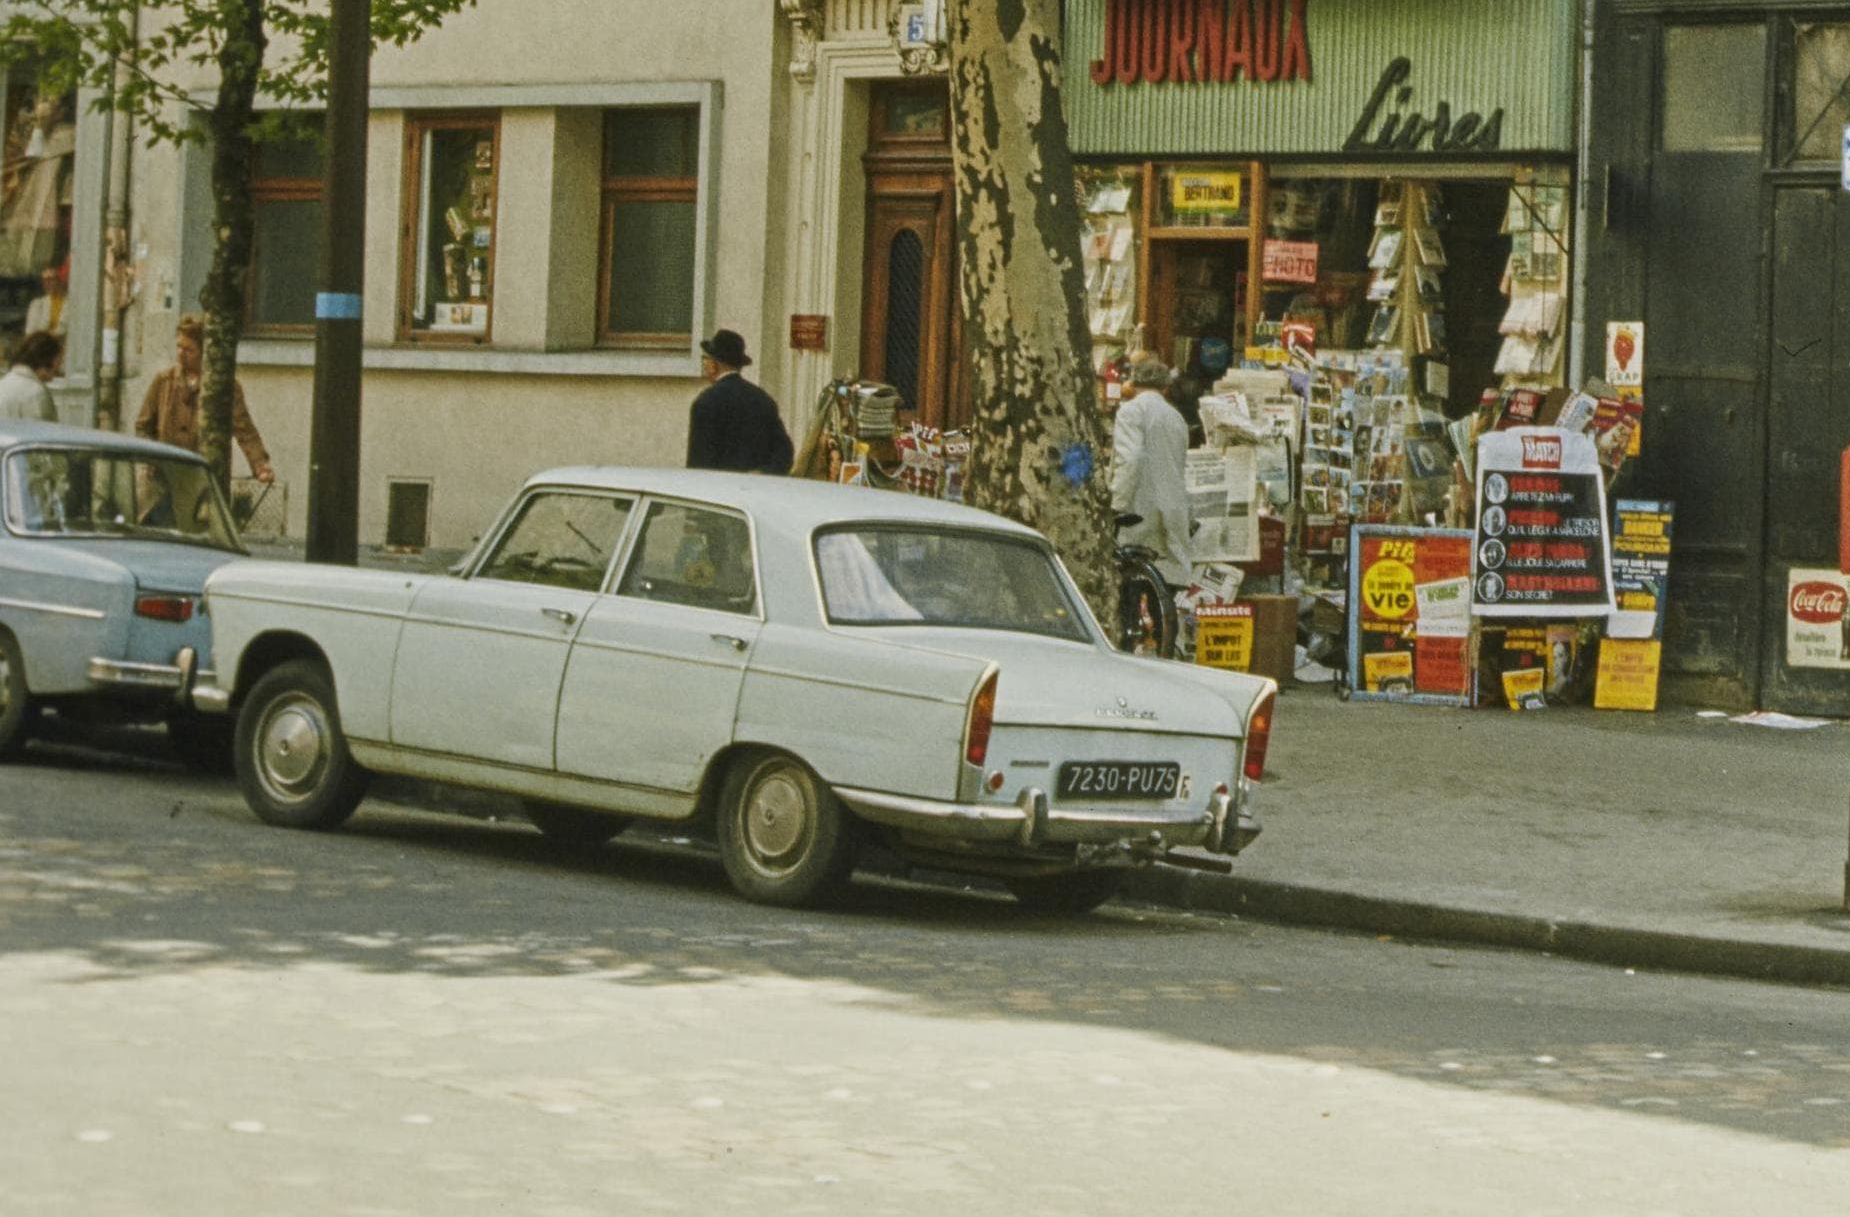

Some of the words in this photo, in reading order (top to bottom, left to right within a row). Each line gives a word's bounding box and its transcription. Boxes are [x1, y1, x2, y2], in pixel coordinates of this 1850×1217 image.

[1341, 56, 1504, 151] Livres
[1184, 185, 1235, 201] BERTRAND
[1524, 441, 1561, 463] MATCH
[1370, 593, 1410, 609] vie
[1793, 588, 1843, 614] Coca-Cola
[1067, 766, 1177, 792] 7230-PU75
